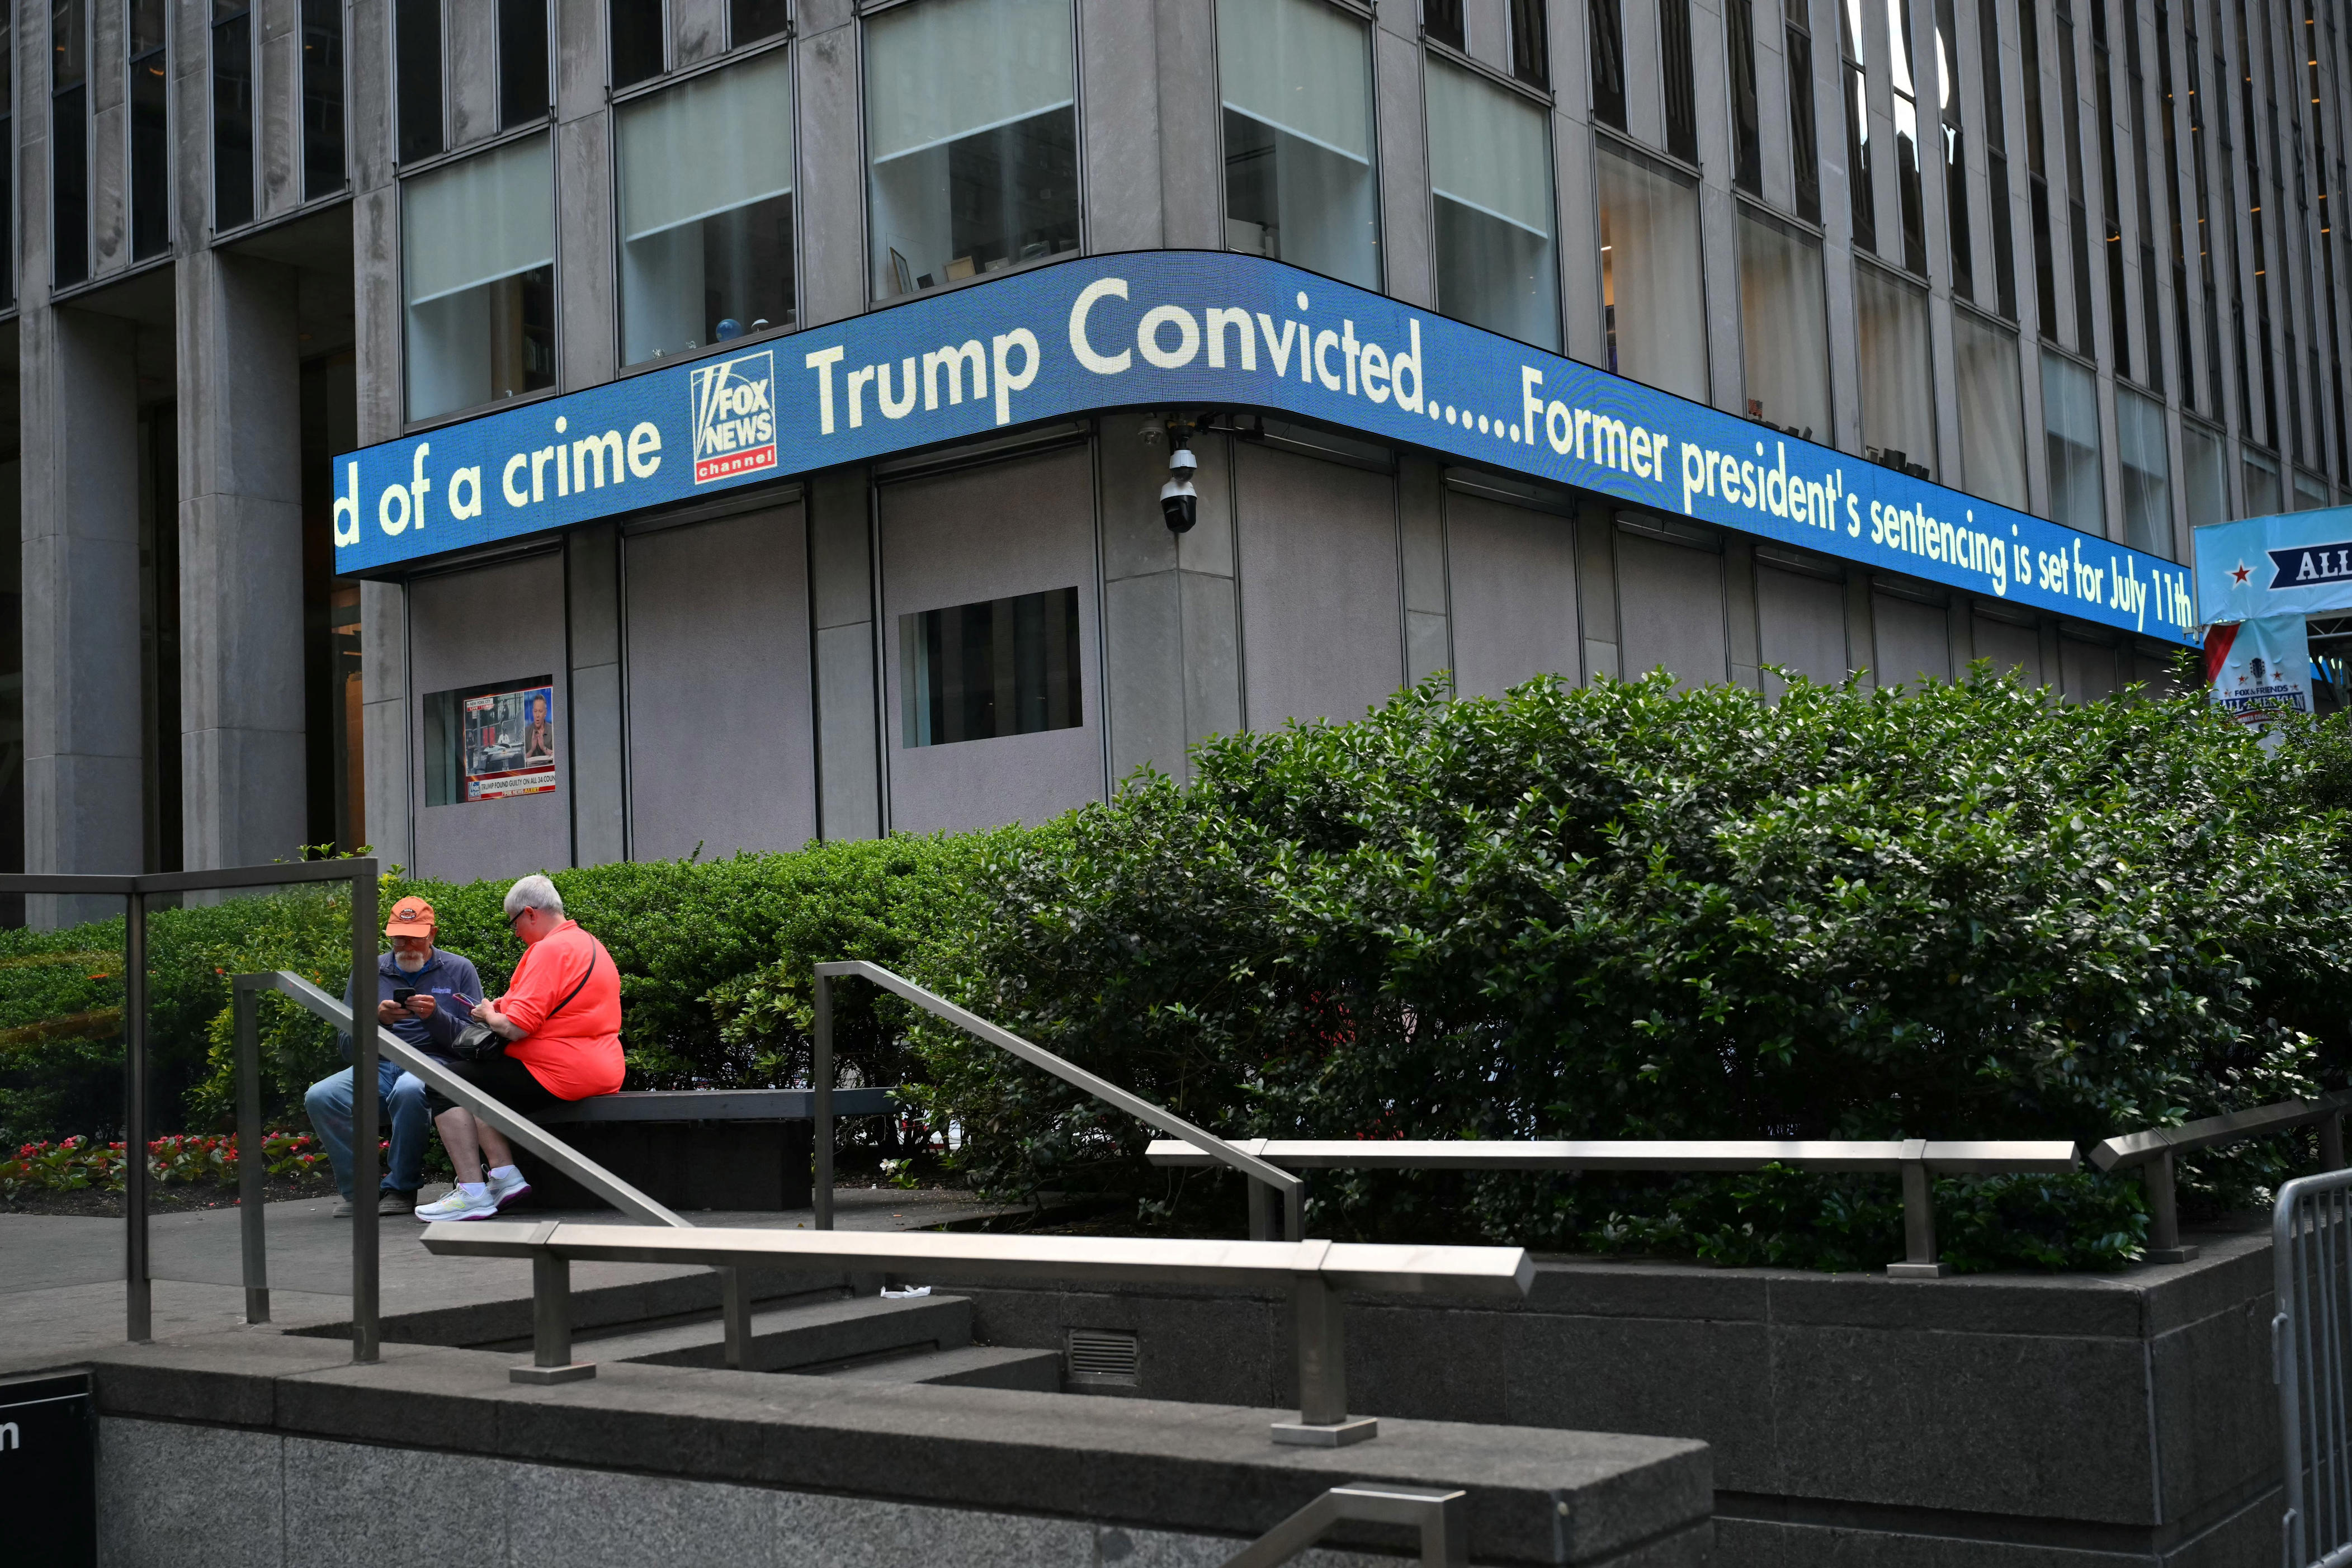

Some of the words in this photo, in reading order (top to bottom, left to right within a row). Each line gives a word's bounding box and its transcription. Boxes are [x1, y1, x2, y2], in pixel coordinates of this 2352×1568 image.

[719, 378, 769, 421] FOX
[706, 412, 773, 455] NEWS
[379, 442, 430, 536] of
[448, 466, 482, 520] a
[502, 416, 662, 508] crime
[699, 449, 773, 477] channel
[806, 328, 1040, 434] Trump
[1682, 441, 1861, 537] president's
[1871, 499, 2006, 596] sentencing
[2011, 523, 2032, 584] is
[2039, 546, 2069, 595] set
[2074, 538, 2104, 604] for
[2110, 555, 2146, 632] July
[2152, 570, 2192, 628] 11th
